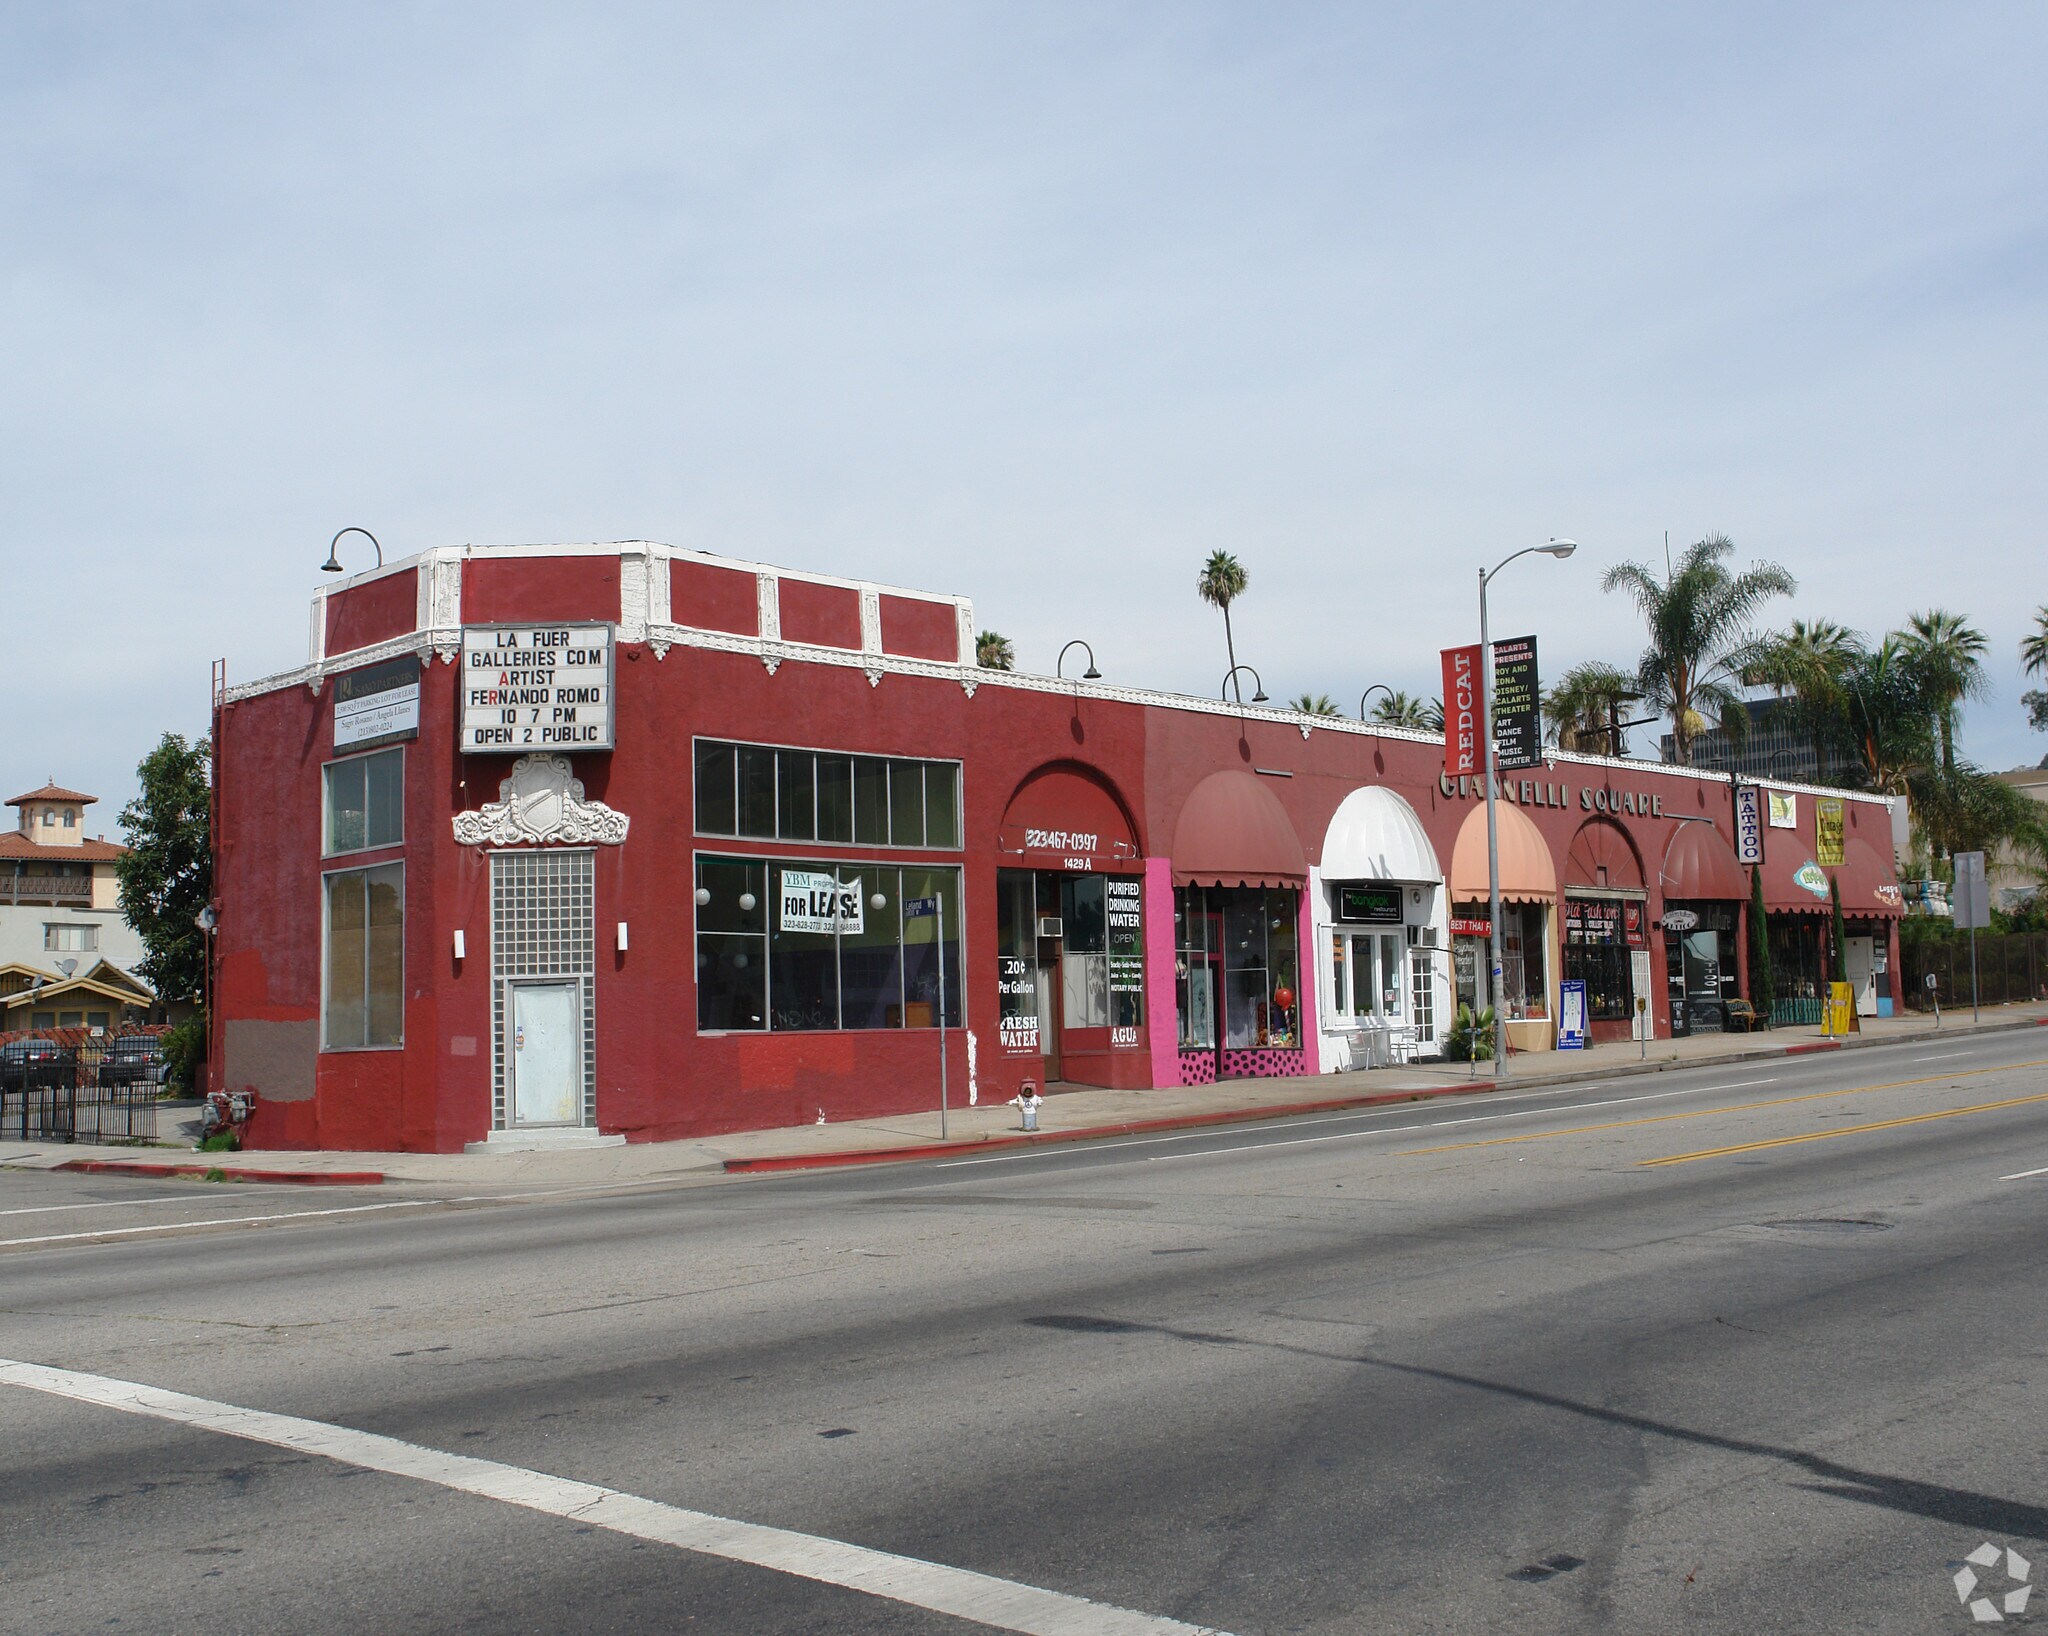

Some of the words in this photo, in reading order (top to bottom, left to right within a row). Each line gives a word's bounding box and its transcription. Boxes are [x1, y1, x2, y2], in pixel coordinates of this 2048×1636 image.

[497, 633, 517, 648] LA
[533, 631, 570, 647] FUER
[1494, 643, 1528, 654] CALARTS
[471, 651, 556, 667] GALLERIES
[567, 649, 601, 665] COM
[1495, 652, 1533, 664] PRESENTS
[1495, 667, 1510, 676] ROY
[1512, 664, 1528, 673] AND
[498, 670, 555, 686] ARTIST
[1495, 676, 1516, 686] EDNA
[471, 689, 549, 705] FERNANDO
[556, 688, 600, 703] ROMO
[1496, 685, 1528, 696] DISNEY/
[1496, 694, 1531, 705] CALARTS
[531, 708, 540, 723] 7
[553, 707, 576, 722] PM
[1455, 653, 1474, 770] REDCAT
[1497, 704, 1531, 715] THEATER
[1497, 718, 1512, 727] ART
[475, 728, 513, 744] OPEN
[523, 728, 532, 743] 2
[542, 726, 598, 742] PUBLIC
[1497, 727, 1522, 737] DANCE
[1498, 738, 1516, 747] FILM
[1499, 747, 1522, 757] MUSIC
[1499, 756, 1531, 766] THEATER
[1580, 786, 1663, 817] SQUARE
[1740, 791, 1759, 858] TATTOO
[1025, 828, 1098, 851] (323)467-0397
[1064, 858, 1084, 870] 1429
[1084, 858, 1092, 870] A
[785, 872, 811, 886] YBM
[1108, 881, 1139, 896] PURIFIED
[785, 897, 806, 917] FOR
[810, 891, 859, 919] LEASE
[905, 899, 922, 911] Leland
[1109, 898, 1140, 912] DRINKING
[1351, 892, 1389, 909] bangkok
[1109, 913, 1140, 927] WATER
[1450, 920, 1467, 931] BEST
[1468, 921, 1484, 931] THAI
[1114, 933, 1135, 944] OPEN
[998, 980, 1010, 994] Per
[1011, 980, 1034, 994] Gallon
[1000, 1016, 1038, 1030] FRESH
[1000, 1030, 1038, 1047] WATER
[1112, 1027, 1137, 1043] AGUA
